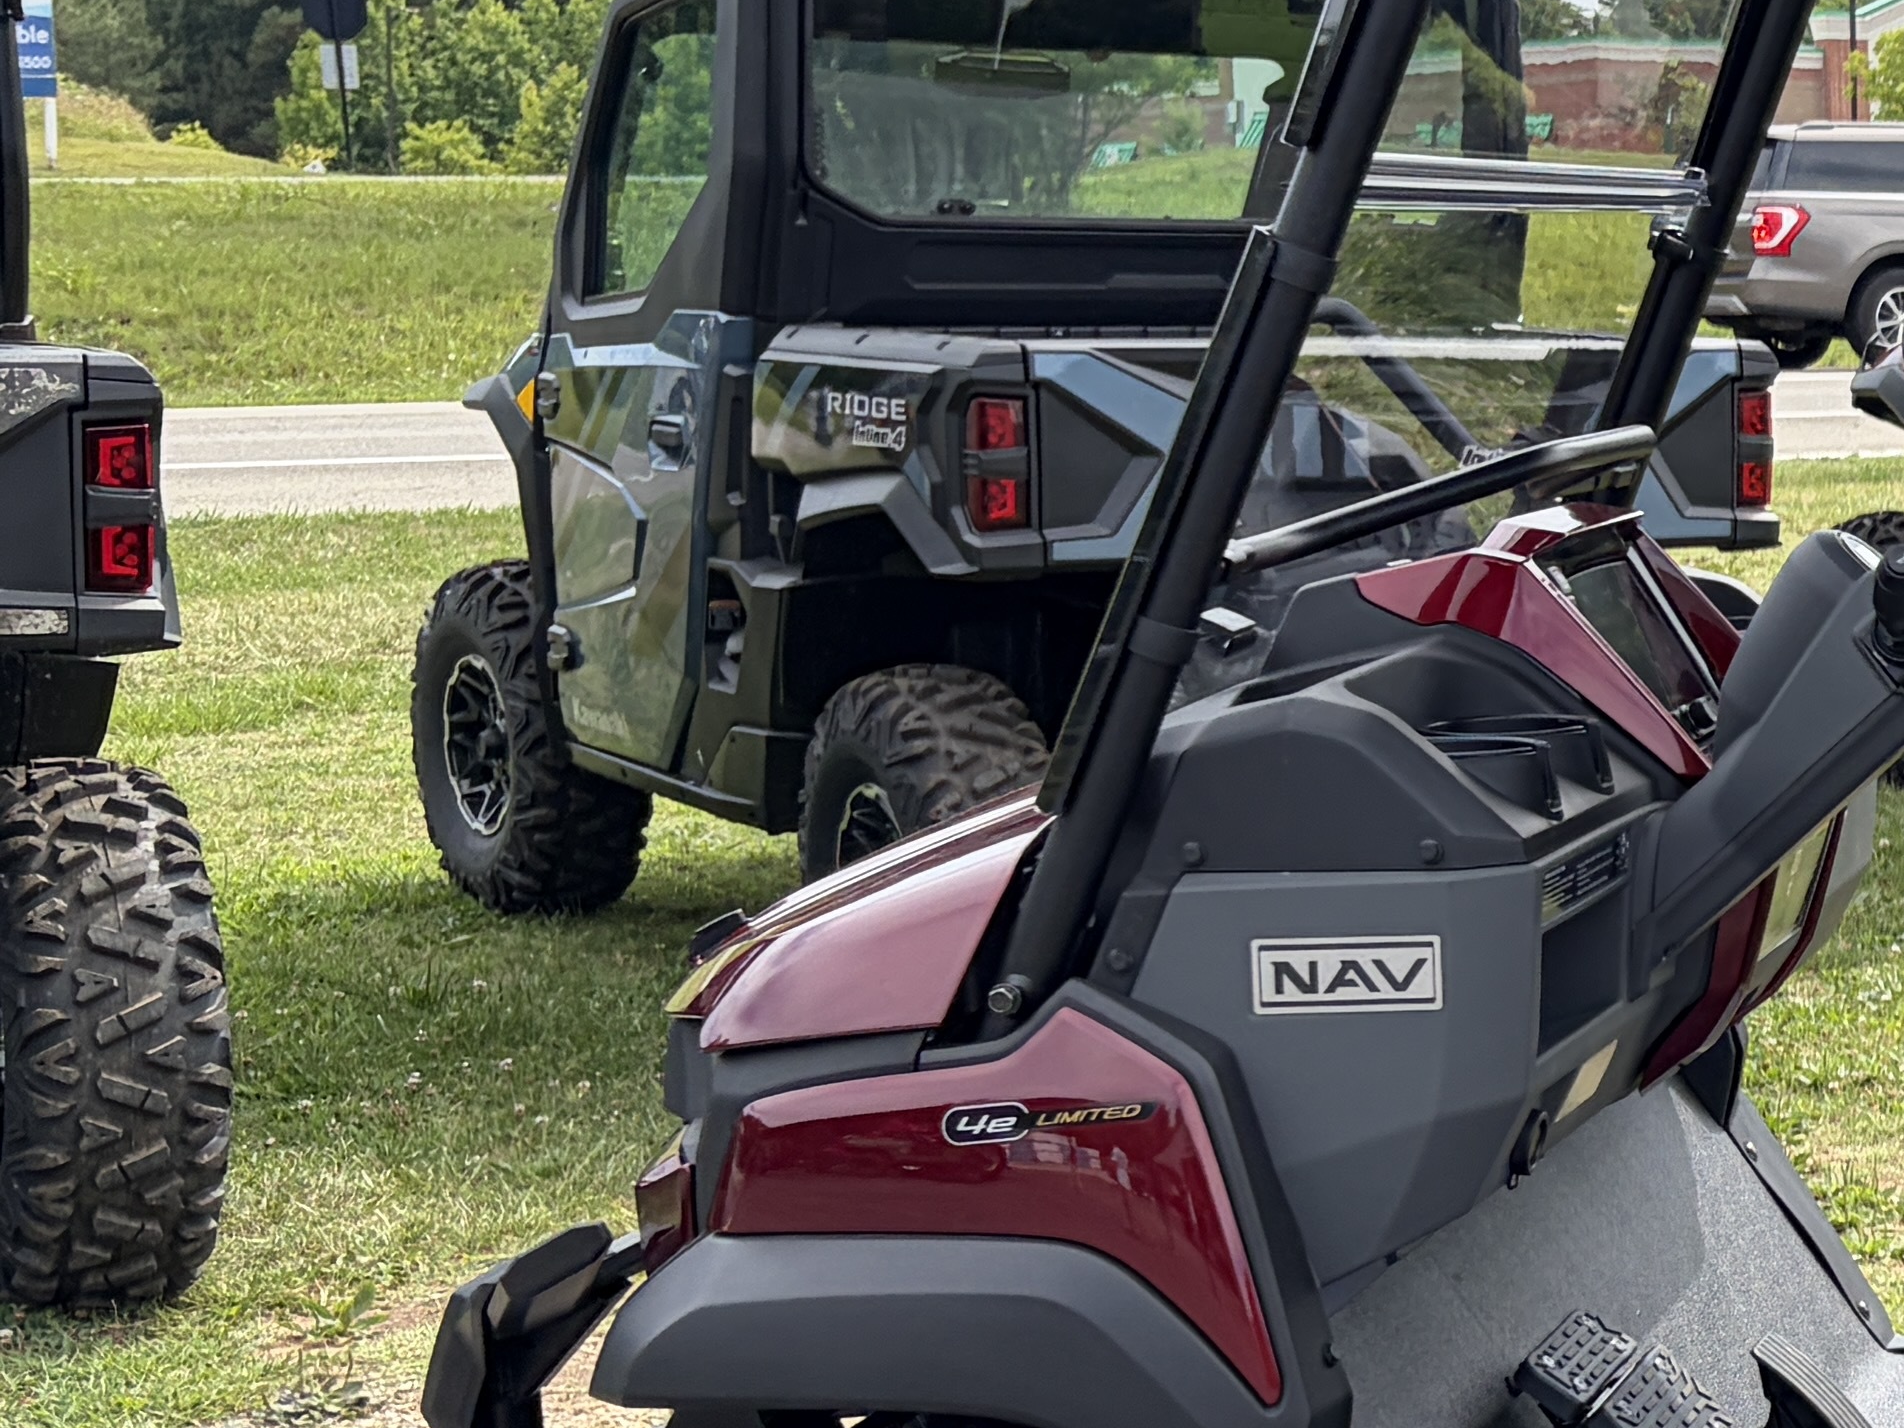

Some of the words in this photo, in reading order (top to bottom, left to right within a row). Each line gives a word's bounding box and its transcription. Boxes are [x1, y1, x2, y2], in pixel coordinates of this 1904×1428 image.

[827, 392, 907, 421] RIDGE
[1270, 958, 1429, 995] NAV
[956, 1114, 1018, 1135] 4e
[1036, 1104, 1142, 1127] LIMITED
